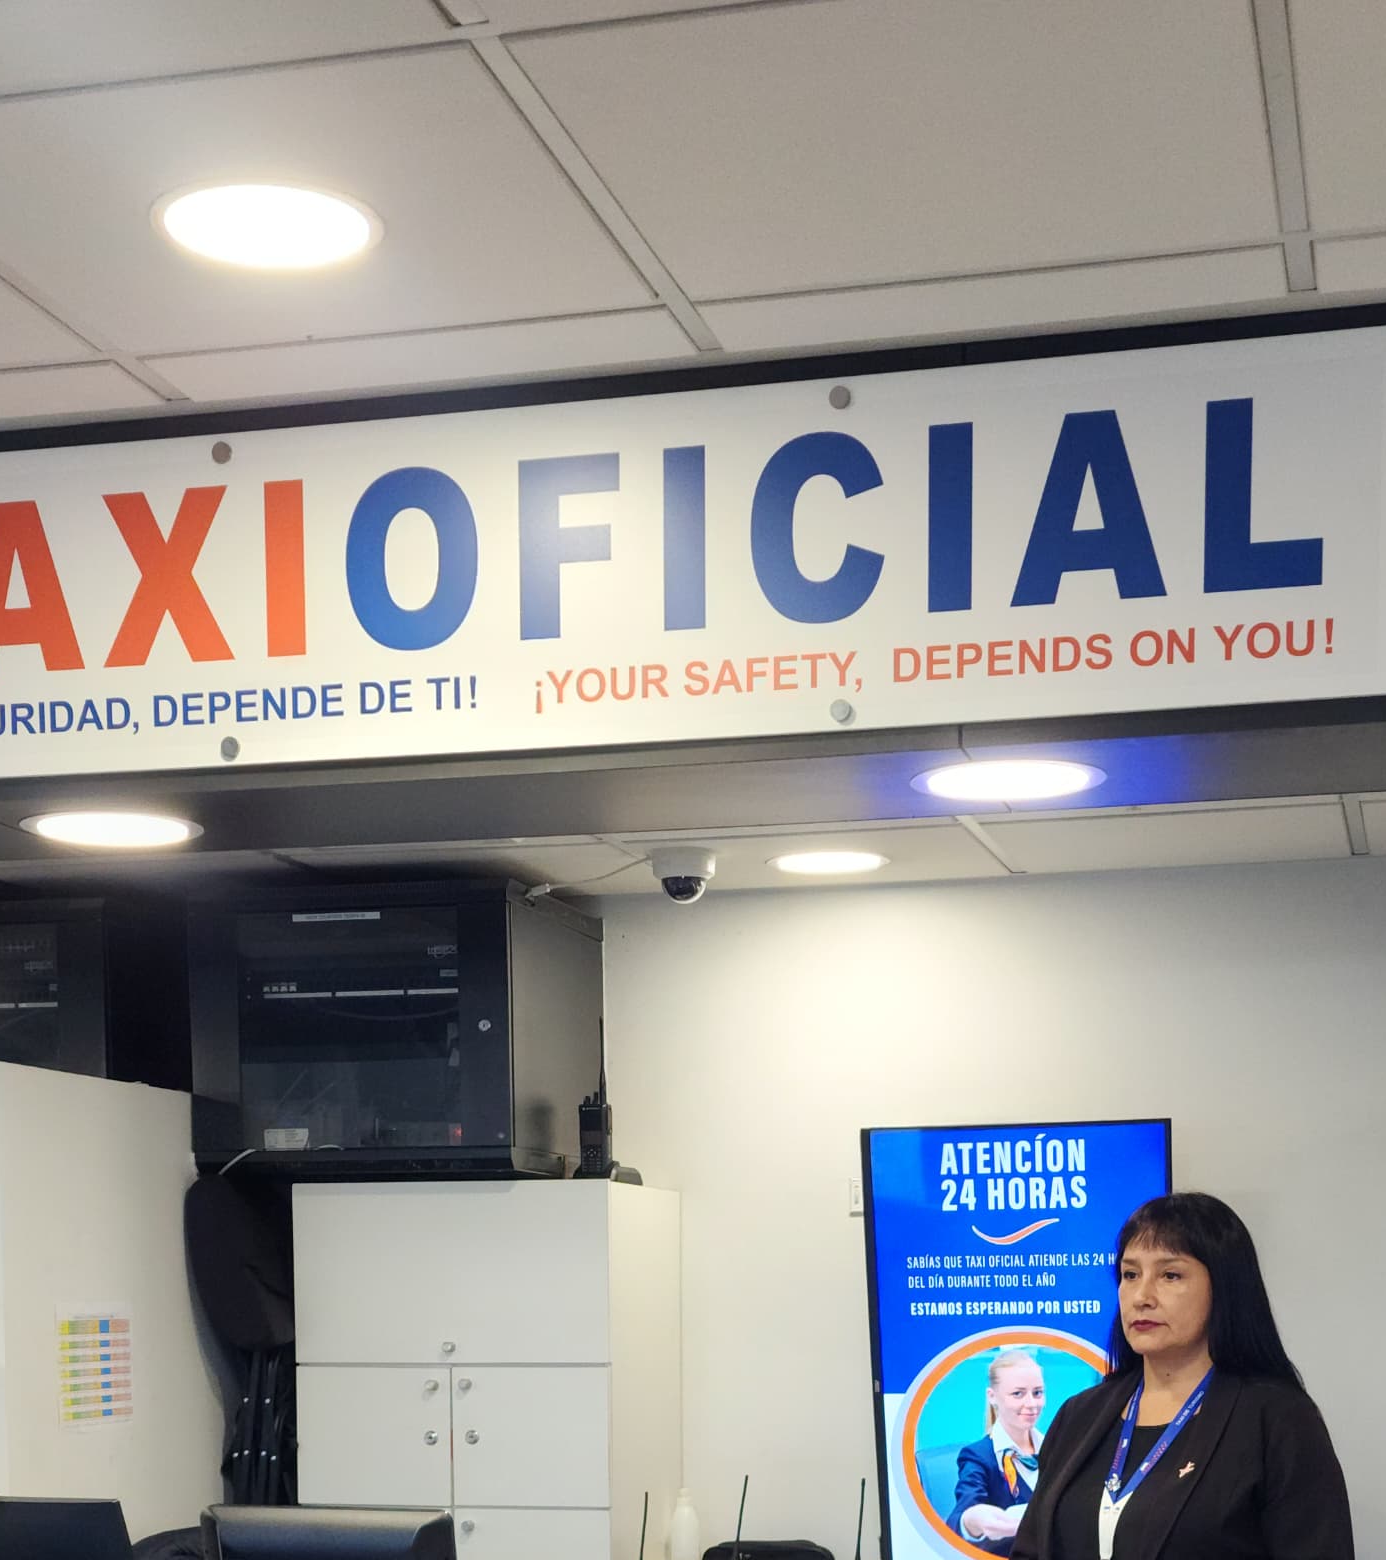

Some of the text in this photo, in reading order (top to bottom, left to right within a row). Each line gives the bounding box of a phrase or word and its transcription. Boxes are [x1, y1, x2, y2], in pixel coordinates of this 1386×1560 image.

[153, 684, 345, 726] DEPENDE
[359, 680, 412, 716] DE
[425, 675, 479, 712] TI!
[533, 663, 669, 714] ¡YOUR
[683, 650, 864, 696] SAFETY,
[892, 632, 1113, 684] DEPENDS
[1129, 627, 1196, 668] ON
[1213, 616, 1335, 661] YOU!
[940, 1133, 1086, 1175] ATENCÍON
[941, 1175, 1088, 1212] 24 HORAS
[906, 1254, 941, 1270] SABÍAS
[944, 1256, 963, 1269] QUE
[965, 1255, 986, 1268] TAXI
[988, 1254, 1026, 1268] OFICIAL
[1028, 1253, 1068, 1267] ATIENDE
[1071, 1253, 1091, 1266] LAS
[1093, 1253, 1105, 1266] 24
[908, 1272, 1056, 1289] DEL DÍA DURANTE TODO EL AÑO
[910, 1300, 1101, 1316] ESTAMOS ESPERANDO POR USTED
